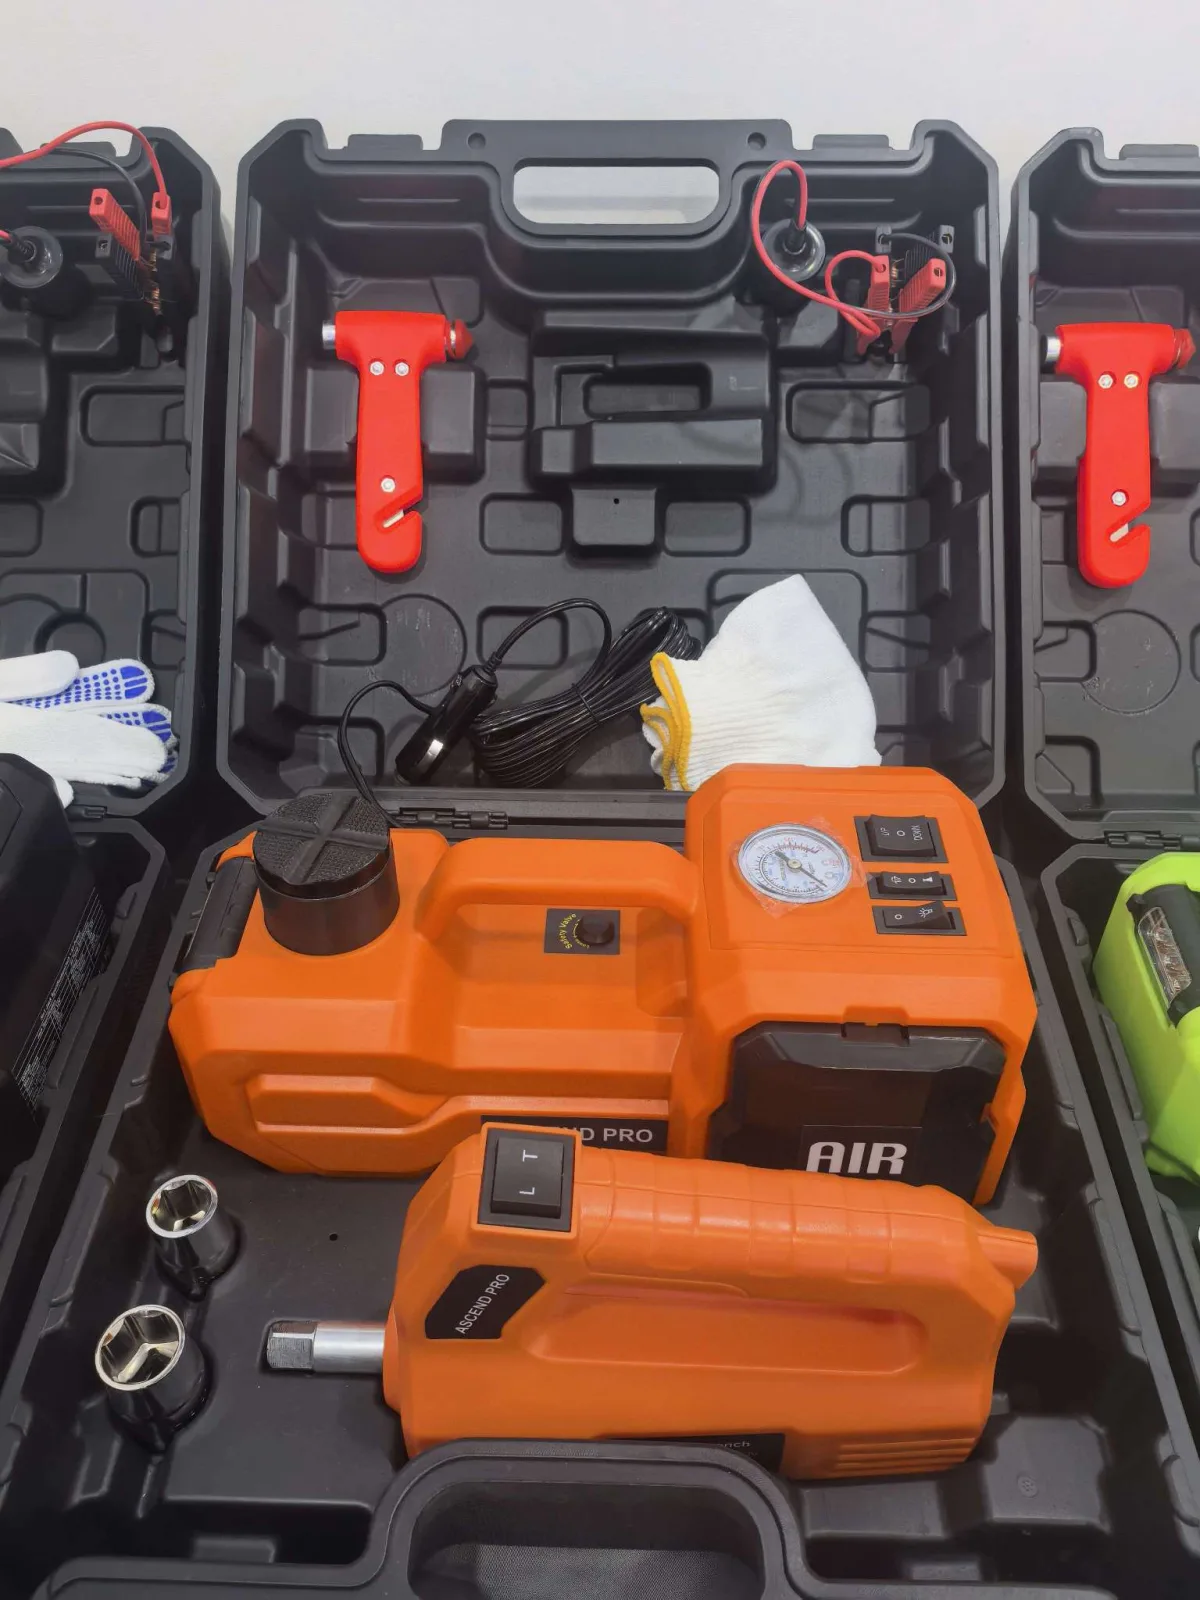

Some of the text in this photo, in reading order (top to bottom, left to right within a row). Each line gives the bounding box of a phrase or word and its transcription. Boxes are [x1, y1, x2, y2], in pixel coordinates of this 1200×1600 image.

[911, 825, 923, 841] DOWN
[559, 913, 577, 928] Valve
[603, 1128, 653, 1143] PRO
[805, 1141, 908, 1175] AIR
[455, 1274, 510, 1334] ASCEND PRO
